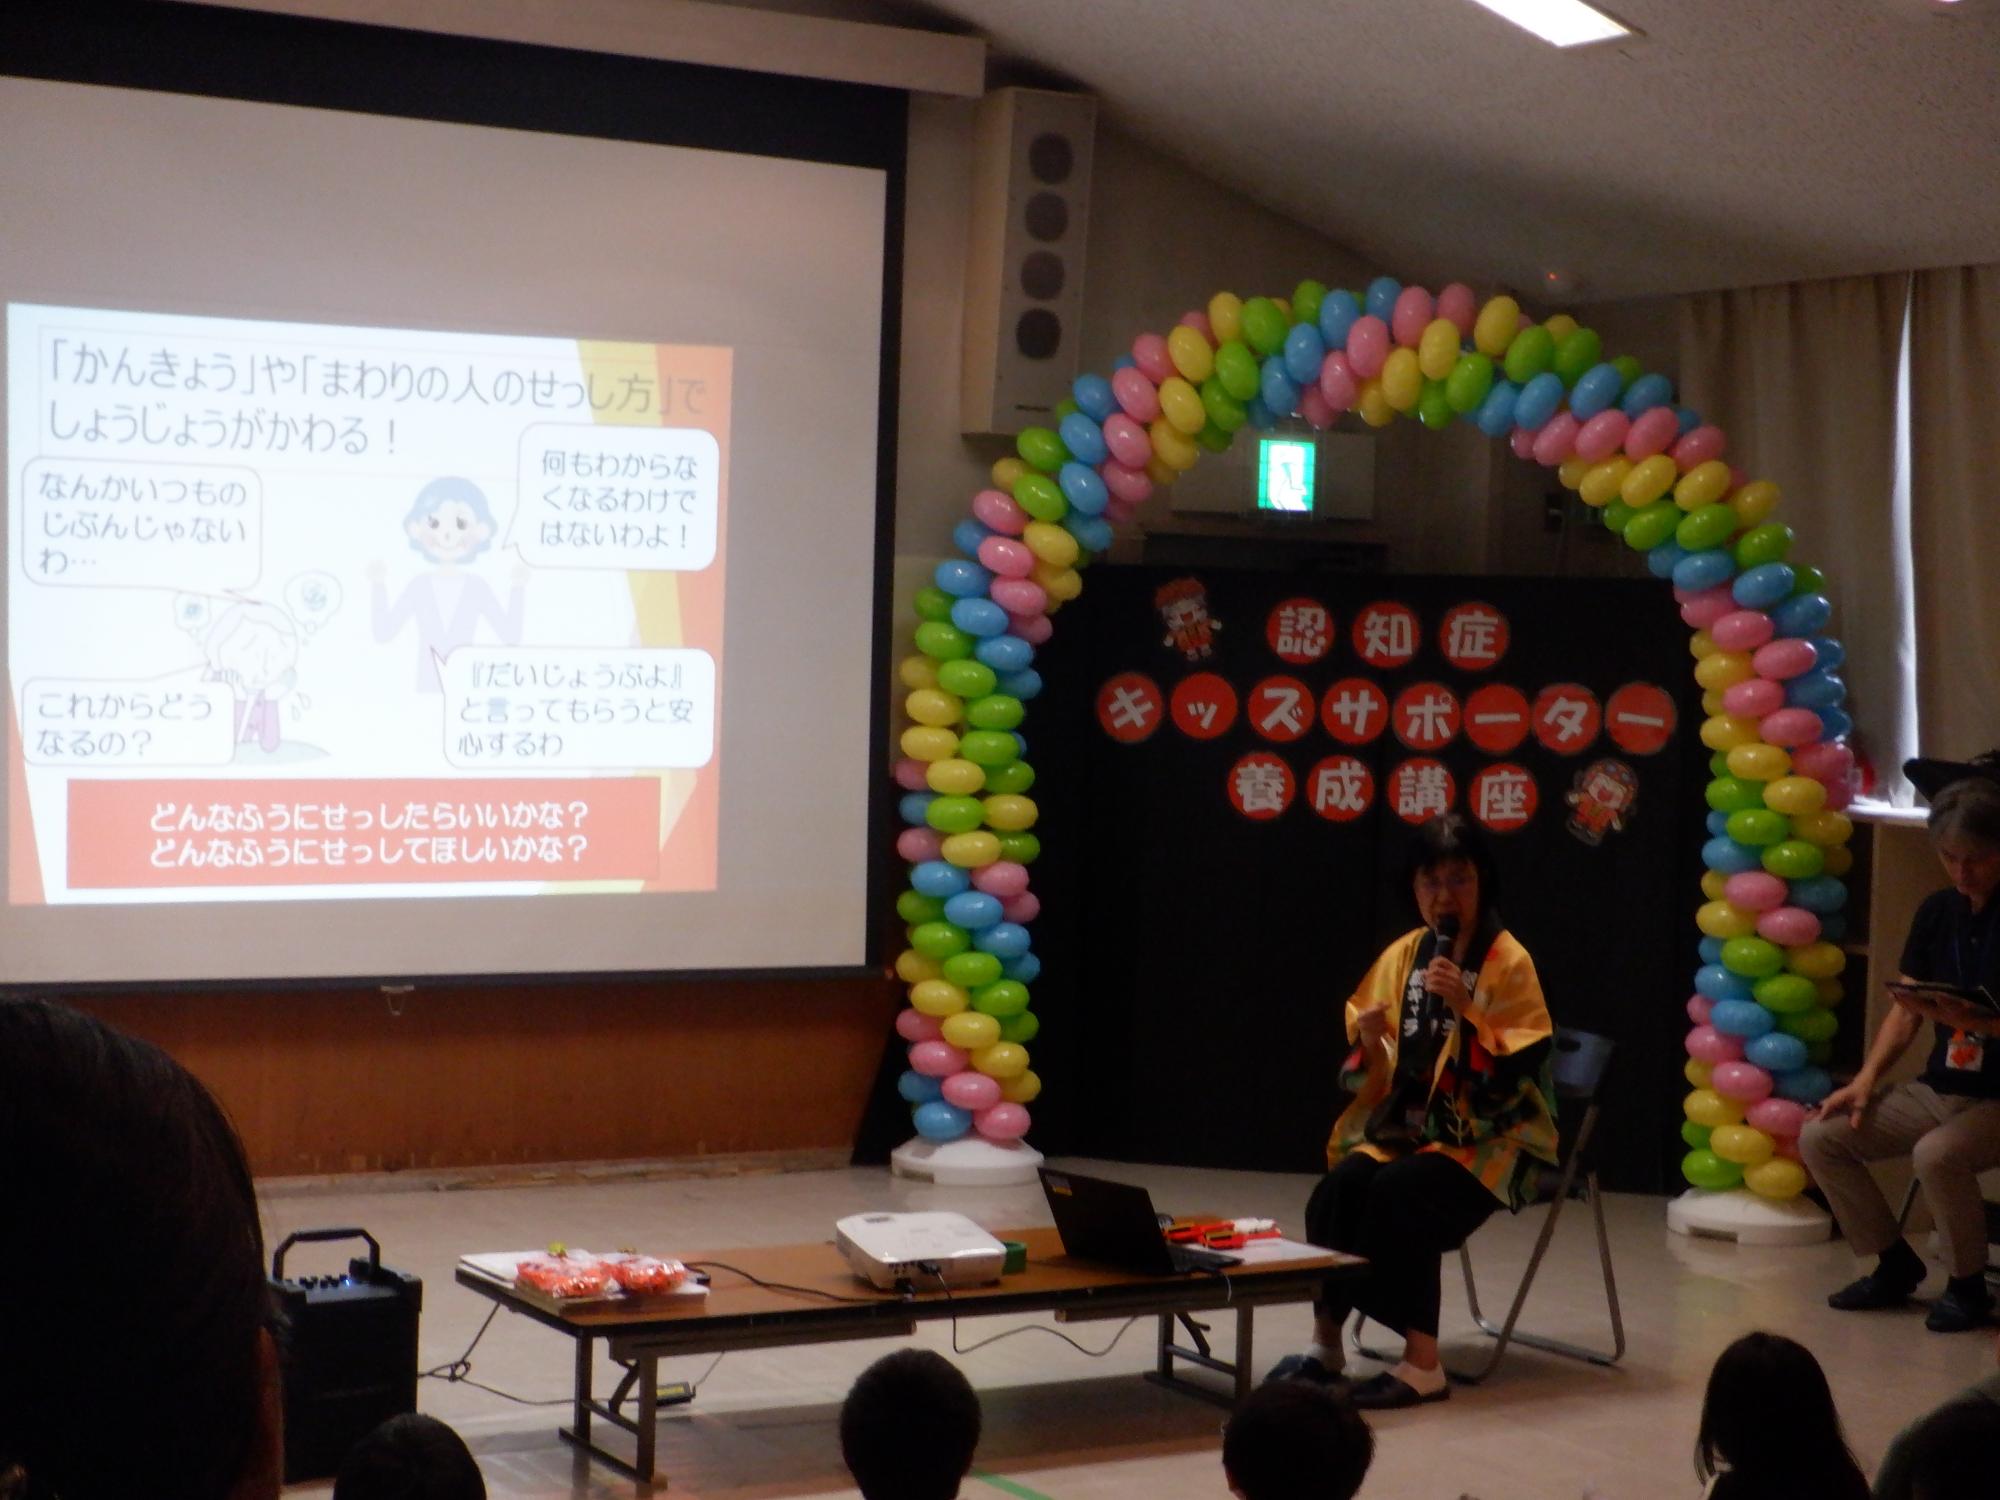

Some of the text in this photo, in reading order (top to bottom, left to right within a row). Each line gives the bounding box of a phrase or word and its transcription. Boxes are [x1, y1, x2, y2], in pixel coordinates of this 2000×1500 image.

[52, 338, 705, 415] 「かんきょう」や「まわりの人のせっし方」で
[50, 400, 395, 455] しょうじょうがかわる！
[542, 450, 697, 480] 何もわからな
[39, 473, 247, 507] なんかいつもの
[542, 486, 697, 515] くなるわけで
[43, 511, 246, 543] じぶんじゃない
[540, 521, 687, 549] はないわよ！
[1276, 606, 1498, 660] 認知症
[472, 661, 683, 689] 『だいじょうぶよ』
[38, 692, 212, 720] これからどう
[460, 697, 694, 724] と言ってもらうと安
[1108, 686, 1665, 742] キッズサポーター
[37, 729, 152, 757] なるの？
[458, 732, 563, 758] 心するわ
[1235, 761, 1529, 822] 養成講座
[150, 800, 588, 832] どんなふうにせっしたらいいかな？
[150, 834, 588, 868] どんなふうにせっしてほしいかな？
